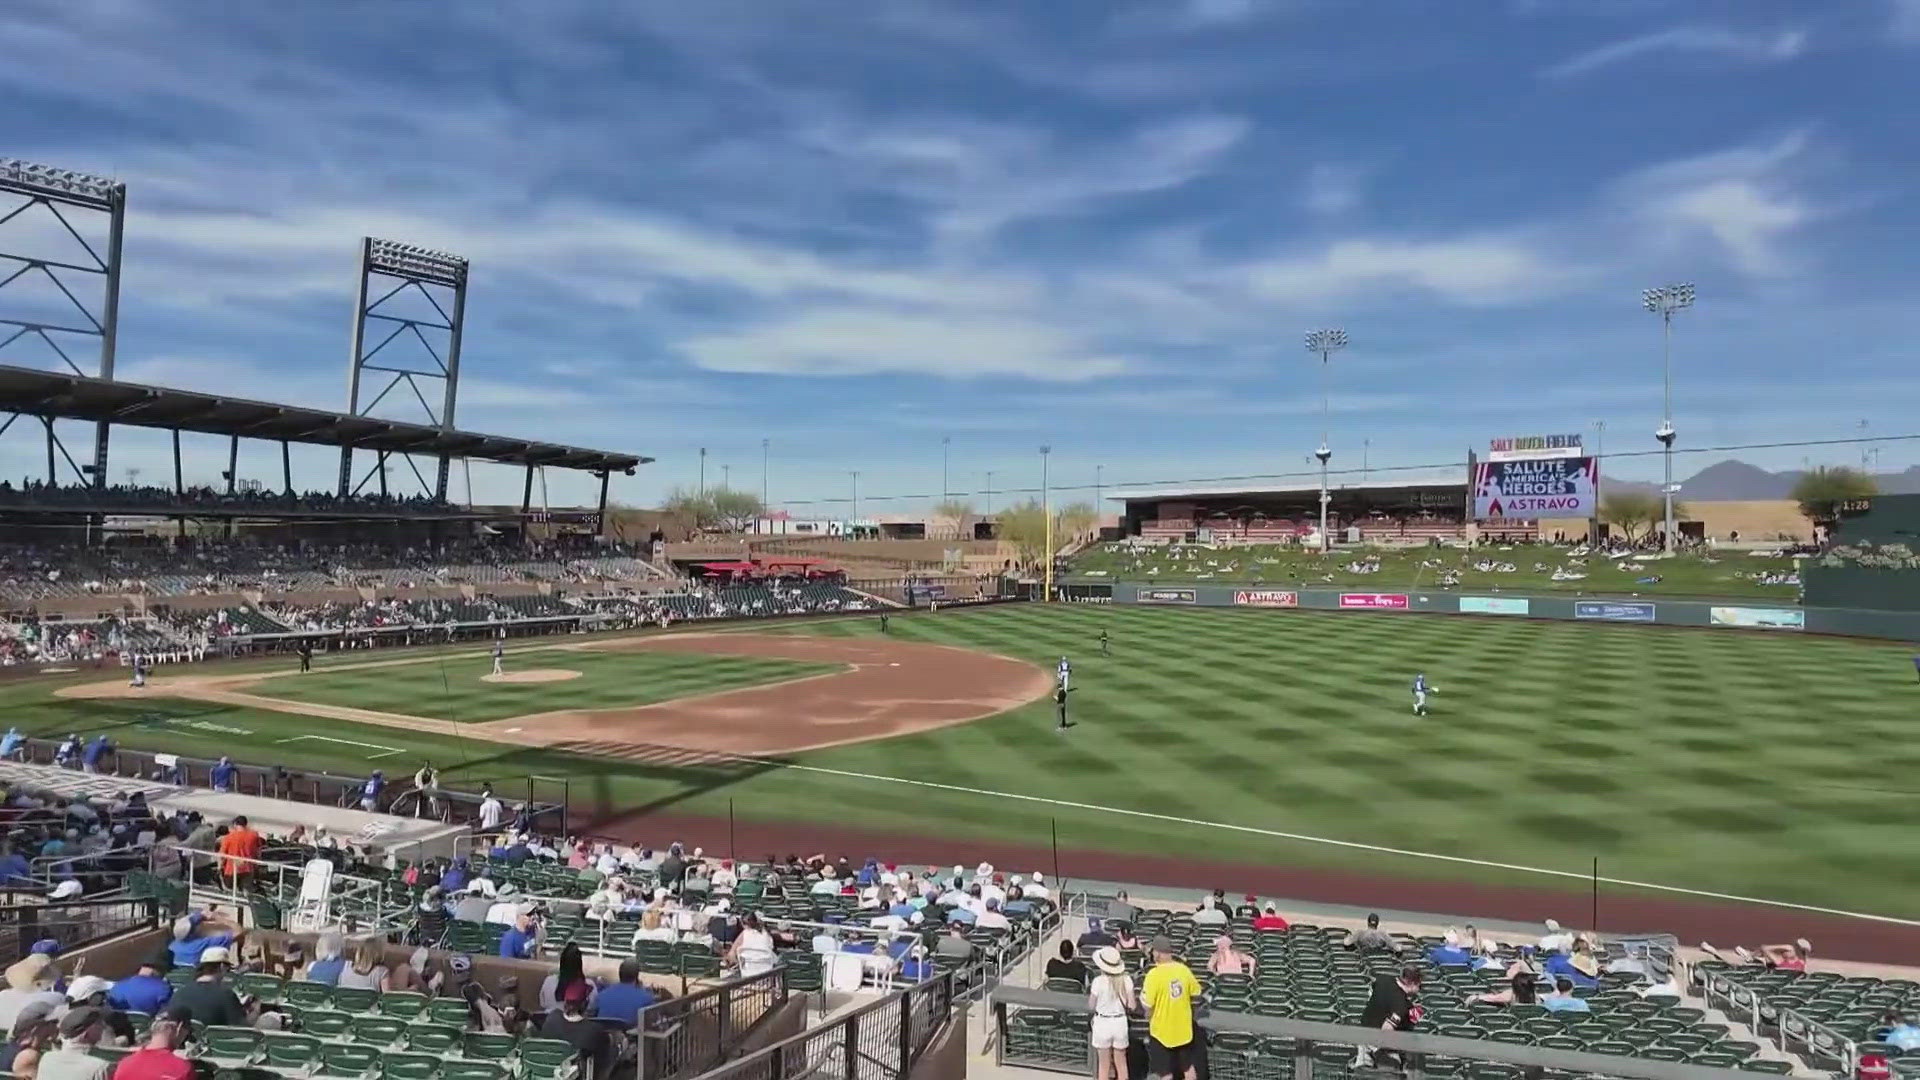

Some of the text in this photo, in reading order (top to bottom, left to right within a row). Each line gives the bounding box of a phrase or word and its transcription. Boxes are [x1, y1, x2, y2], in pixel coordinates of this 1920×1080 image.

[1503, 461, 1566, 474] SALUTE
[1503, 482, 1566, 495] HEROES
[1508, 498, 1579, 510] ASTRAVO
[1843, 500, 1869, 511] 1:28
